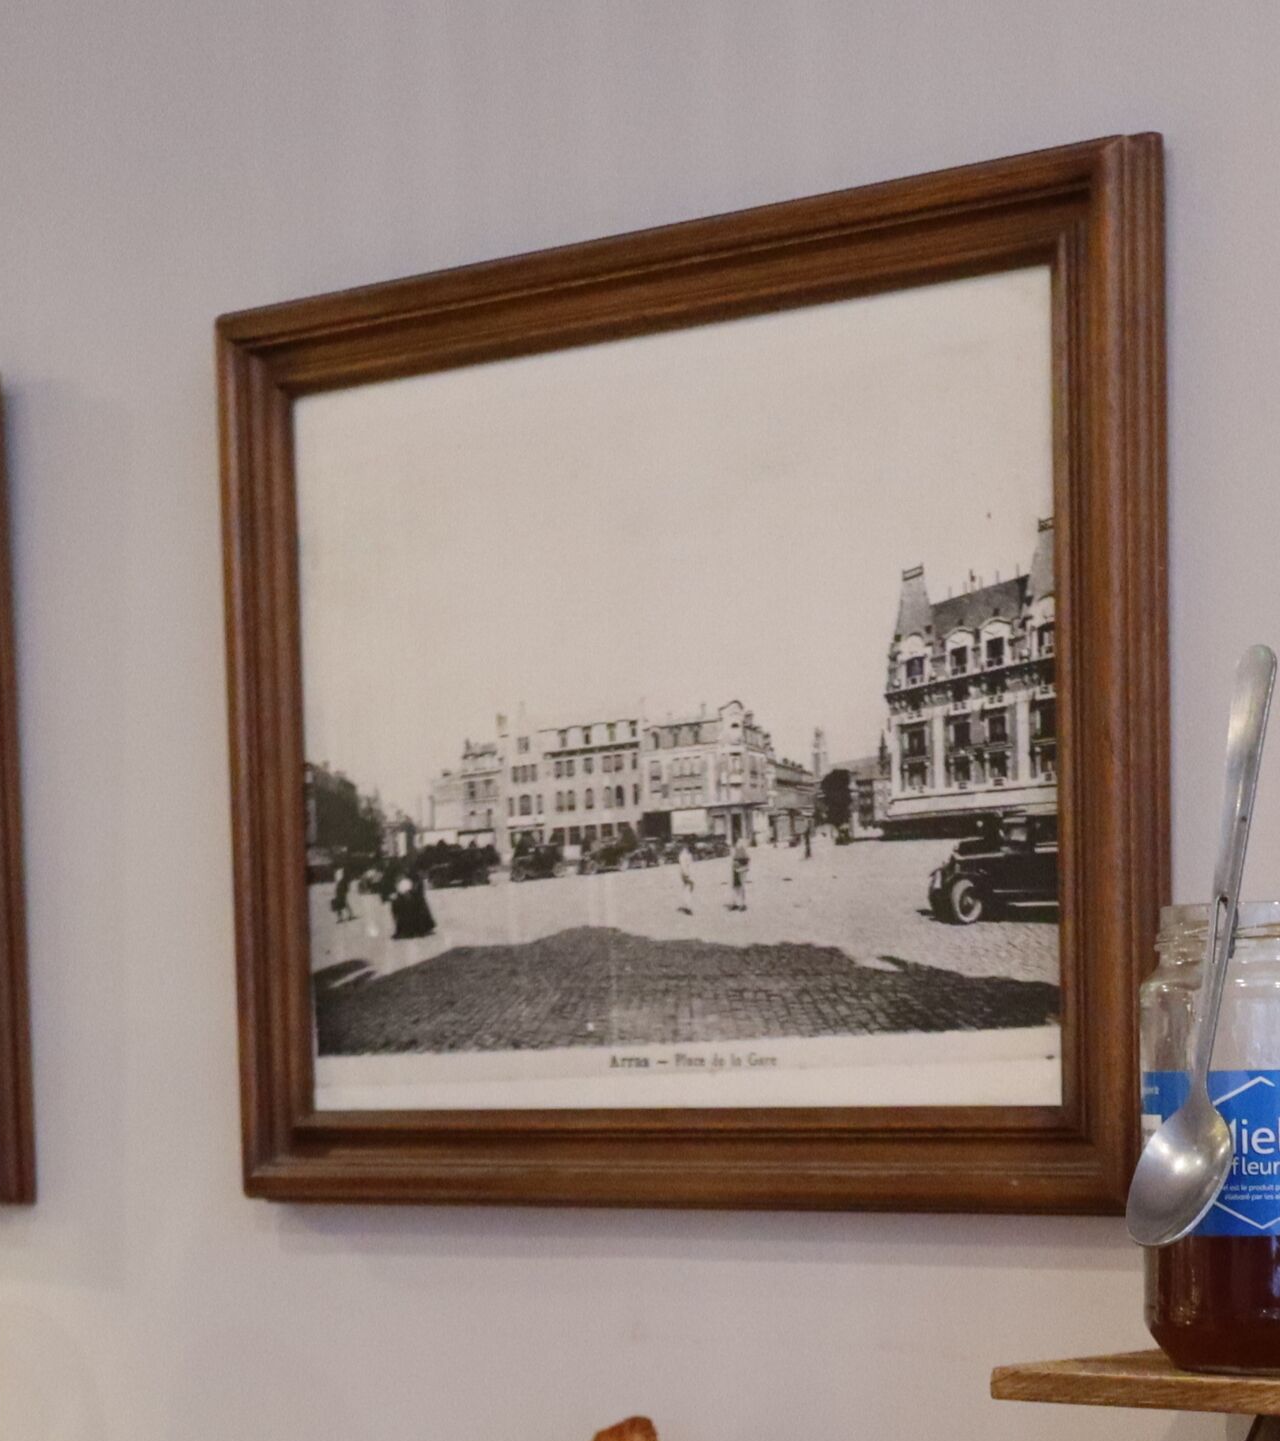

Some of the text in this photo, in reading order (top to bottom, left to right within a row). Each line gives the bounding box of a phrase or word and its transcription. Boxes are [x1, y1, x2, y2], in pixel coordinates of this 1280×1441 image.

[609, 1054, 650, 1068] Arras
[675, 1053, 705, 1067] Place
[748, 1052, 777, 1067] Gare
